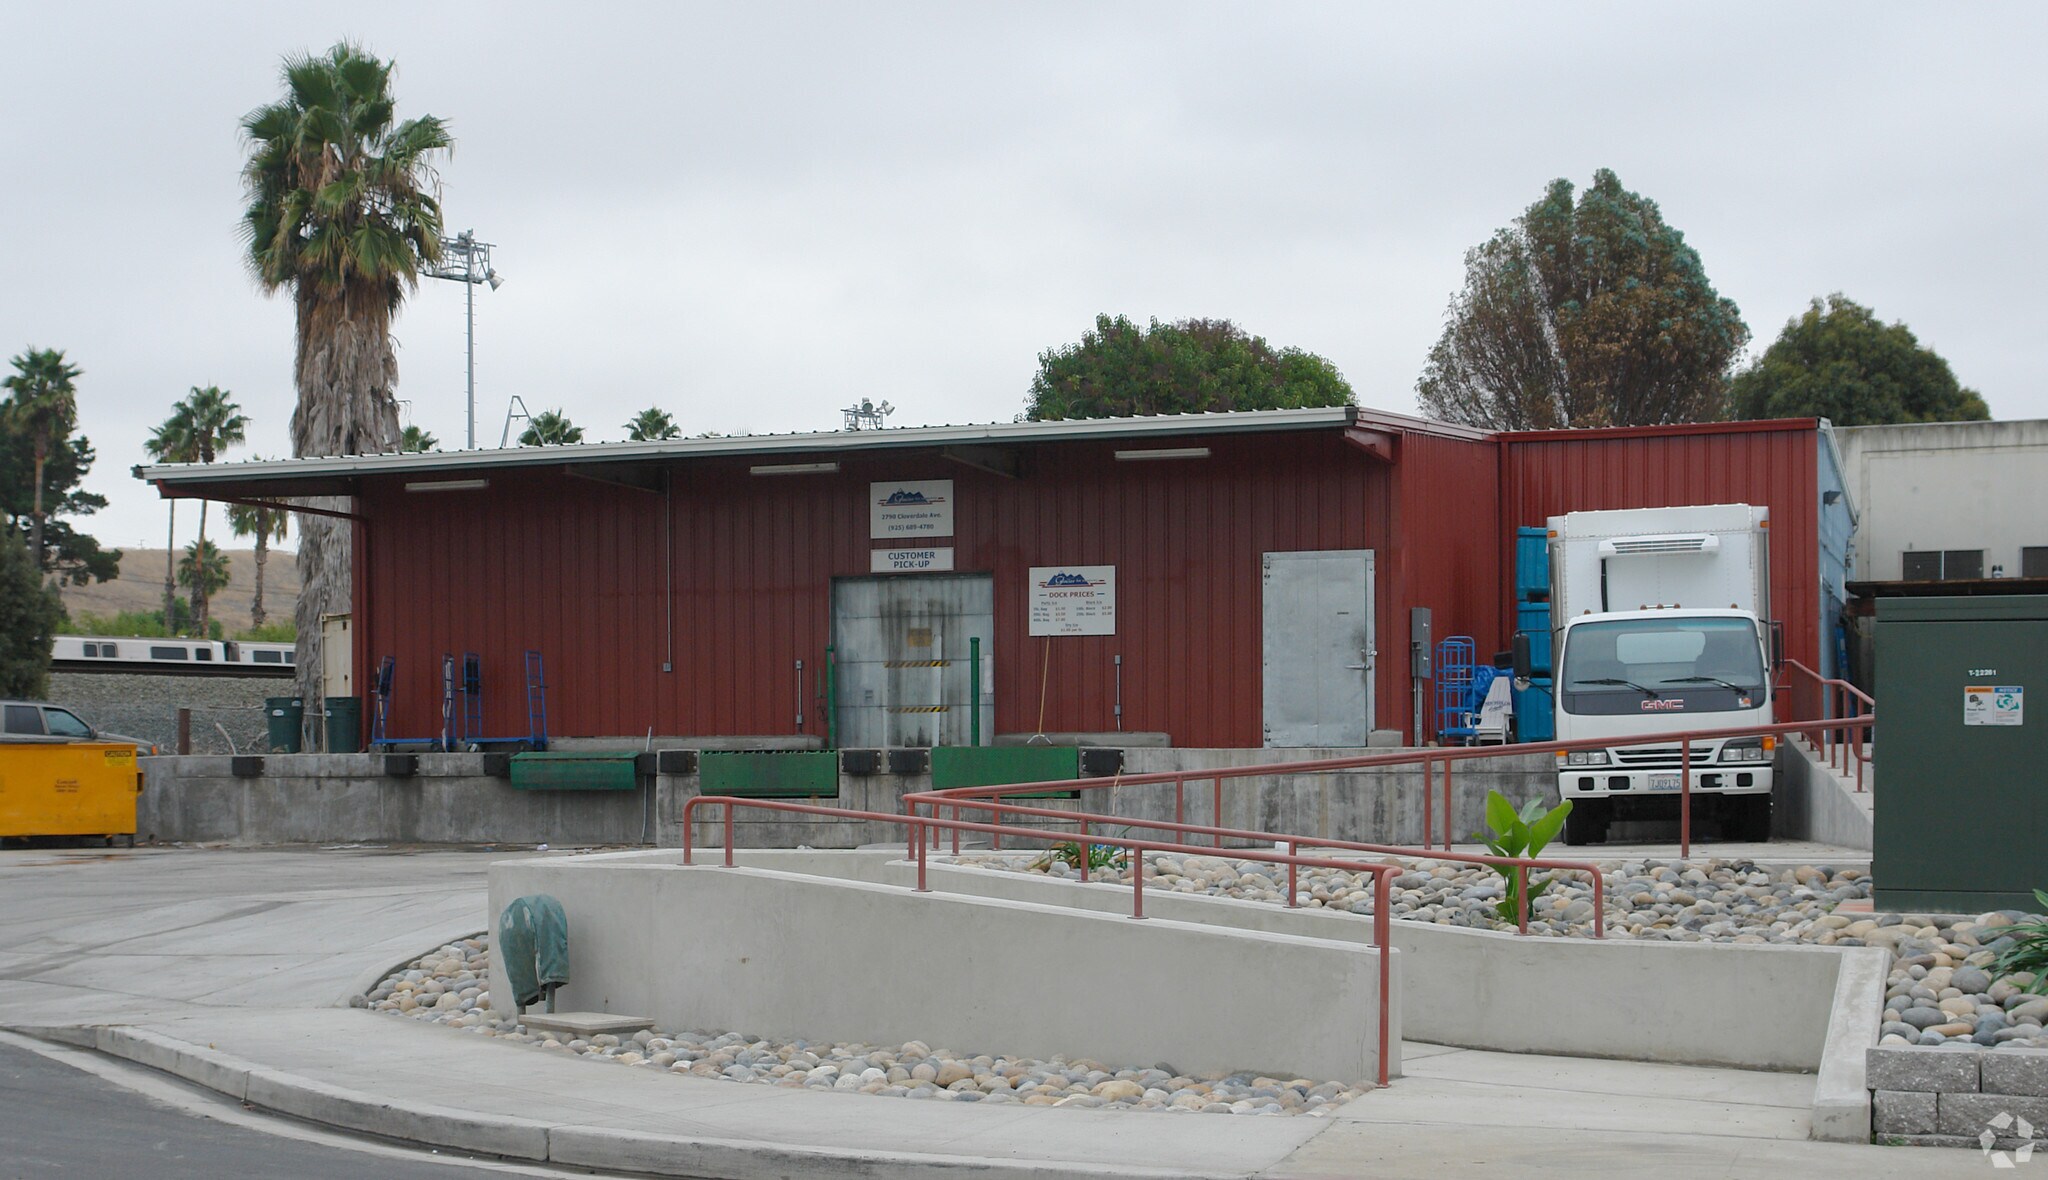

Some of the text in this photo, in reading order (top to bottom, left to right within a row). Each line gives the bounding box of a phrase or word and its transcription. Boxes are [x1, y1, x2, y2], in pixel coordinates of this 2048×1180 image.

[888, 551, 935, 560] CUSTOMER
[893, 560, 930, 568] PICK-UP
[1641, 699, 1684, 711] GMC
